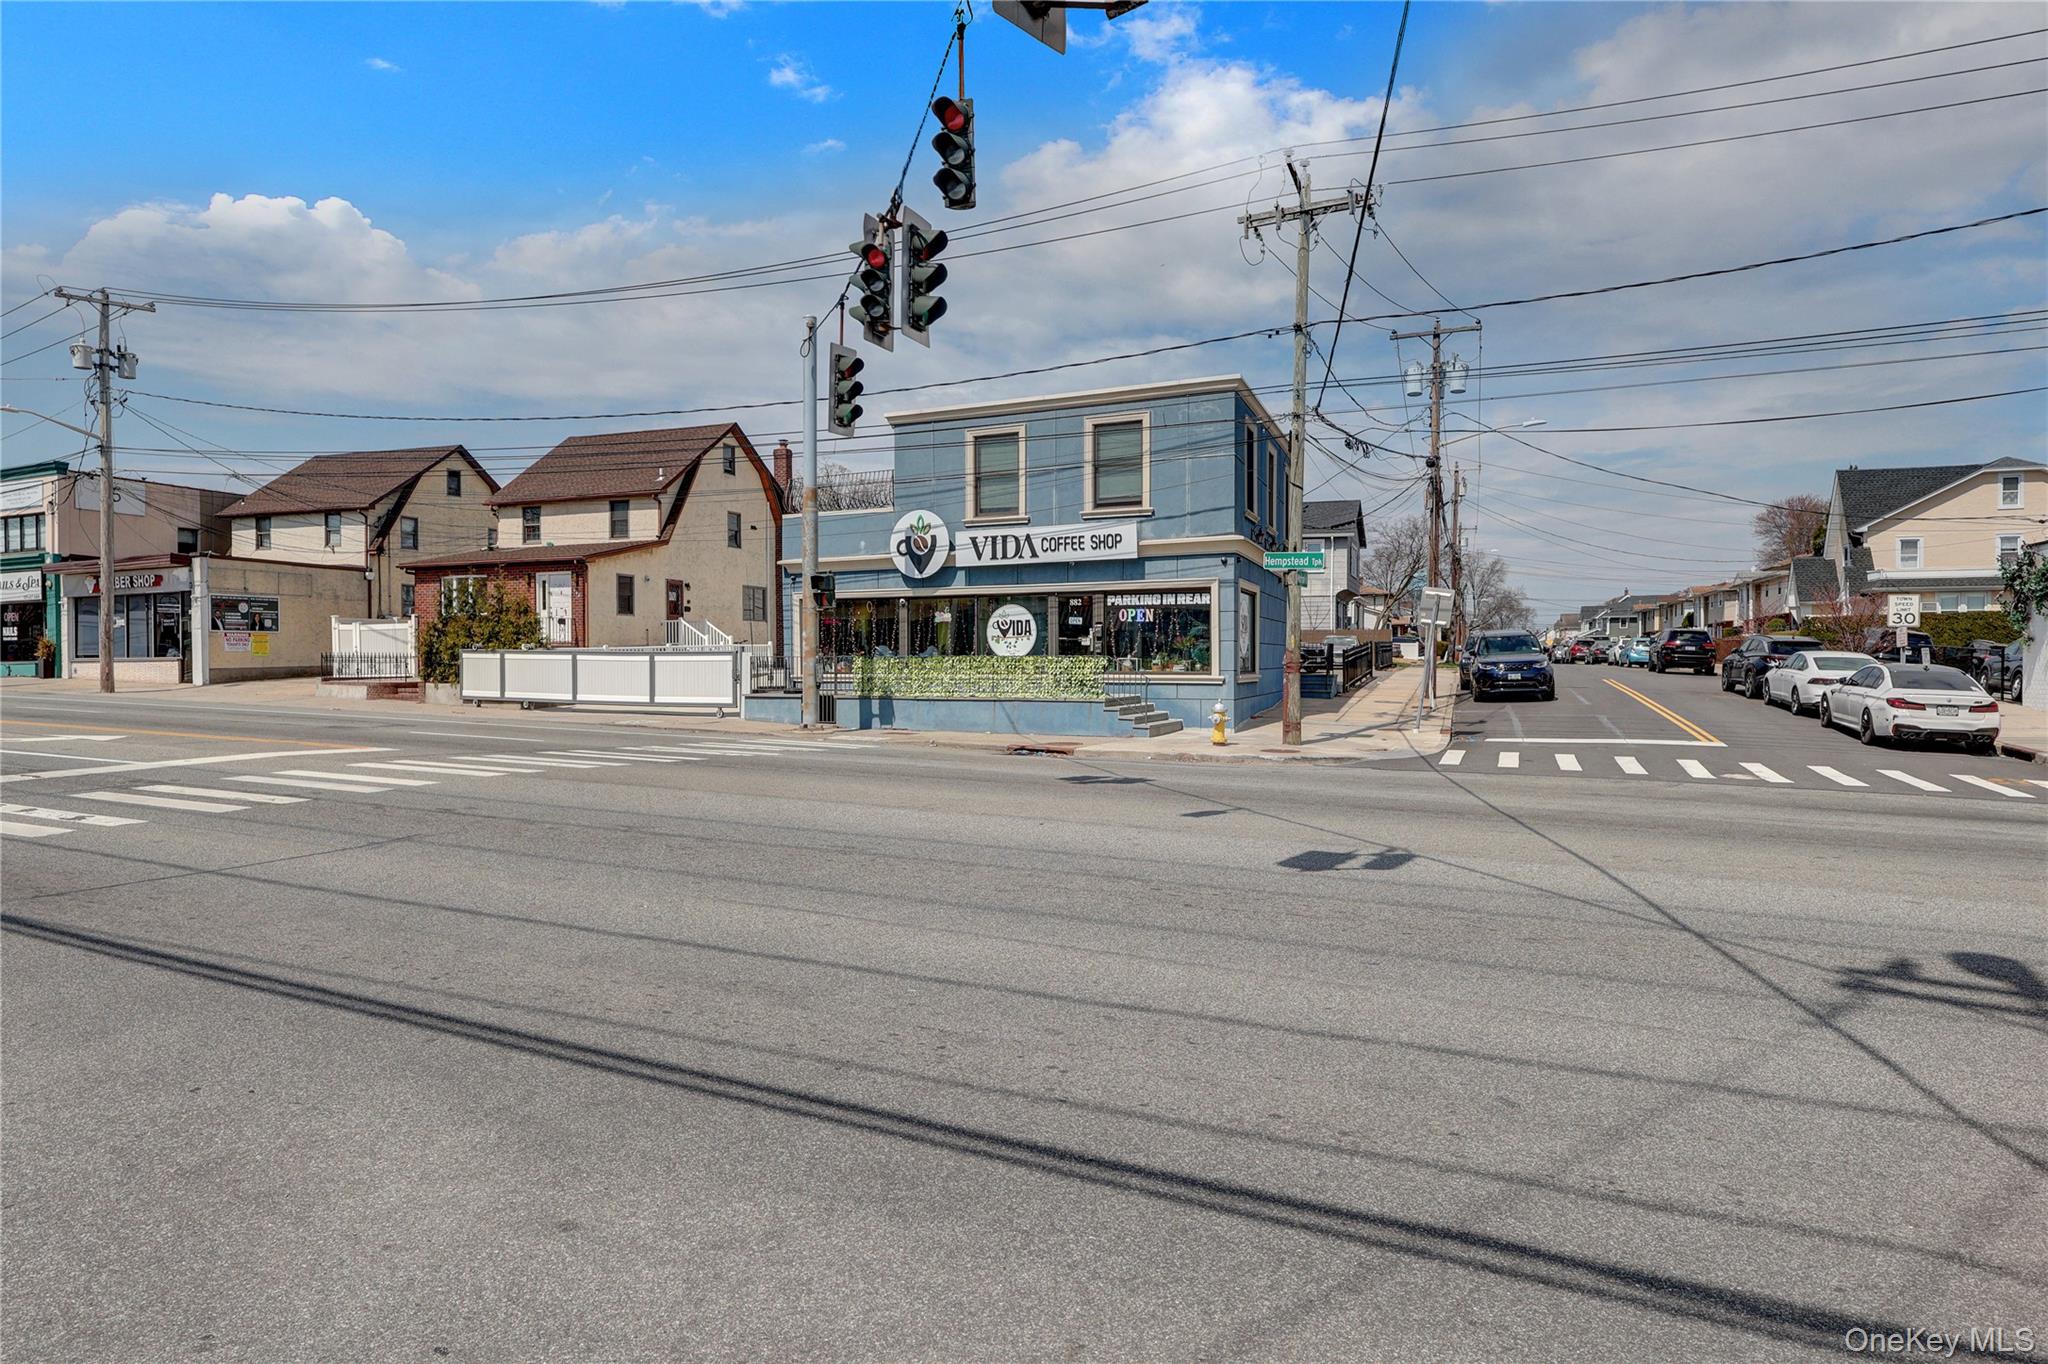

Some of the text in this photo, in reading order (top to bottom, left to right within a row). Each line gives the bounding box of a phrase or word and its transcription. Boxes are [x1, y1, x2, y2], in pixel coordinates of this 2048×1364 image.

[969, 533, 1122, 561] VIDA COFFEE SHOP
[1265, 556, 1308, 567] Hempstead
[16, 578, 21, 588] &
[133, 574, 155, 588] SHOP
[1069, 598, 1082, 606] 882
[1107, 593, 1211, 606] PARKING IN REAR
[1119, 608, 1154, 622] OPEN
[1892, 612, 1916, 624] 30
[2, 626, 18, 637] NAILS
[997, 619, 1032, 638] VIDA
